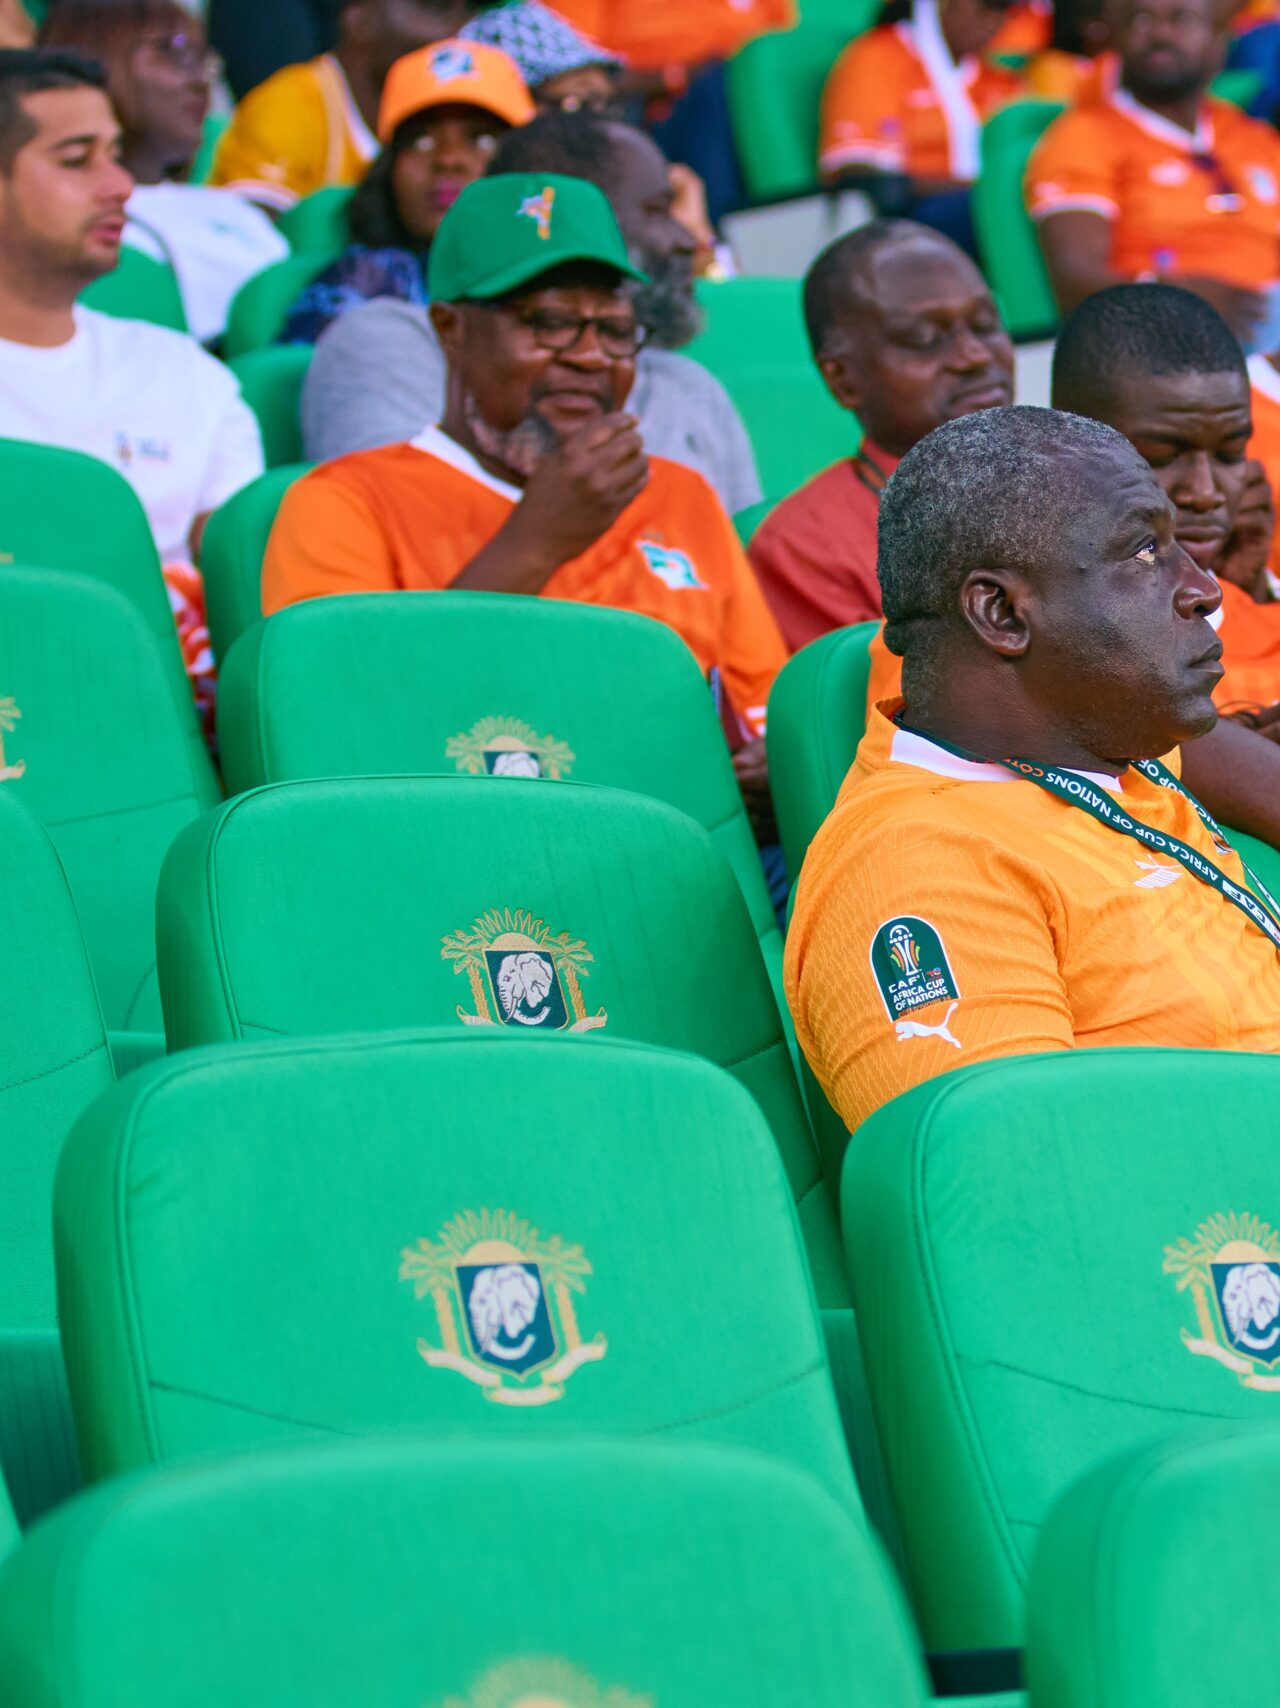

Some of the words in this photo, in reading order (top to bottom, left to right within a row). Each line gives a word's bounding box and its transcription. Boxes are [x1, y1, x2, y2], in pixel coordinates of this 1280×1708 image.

[1045, 772, 1112, 818] NATIONS
[1112, 814, 1133, 830] OF
[1135, 828, 1167, 847] CUP
[1168, 841, 1219, 881] AFRICA
[888, 977, 917, 994] CAF
[893, 984, 924, 1004] AFRICA
[925, 978, 945, 991] CUP
[895, 999, 907, 1011] OF
[907, 986, 948, 1005] NATIONS
